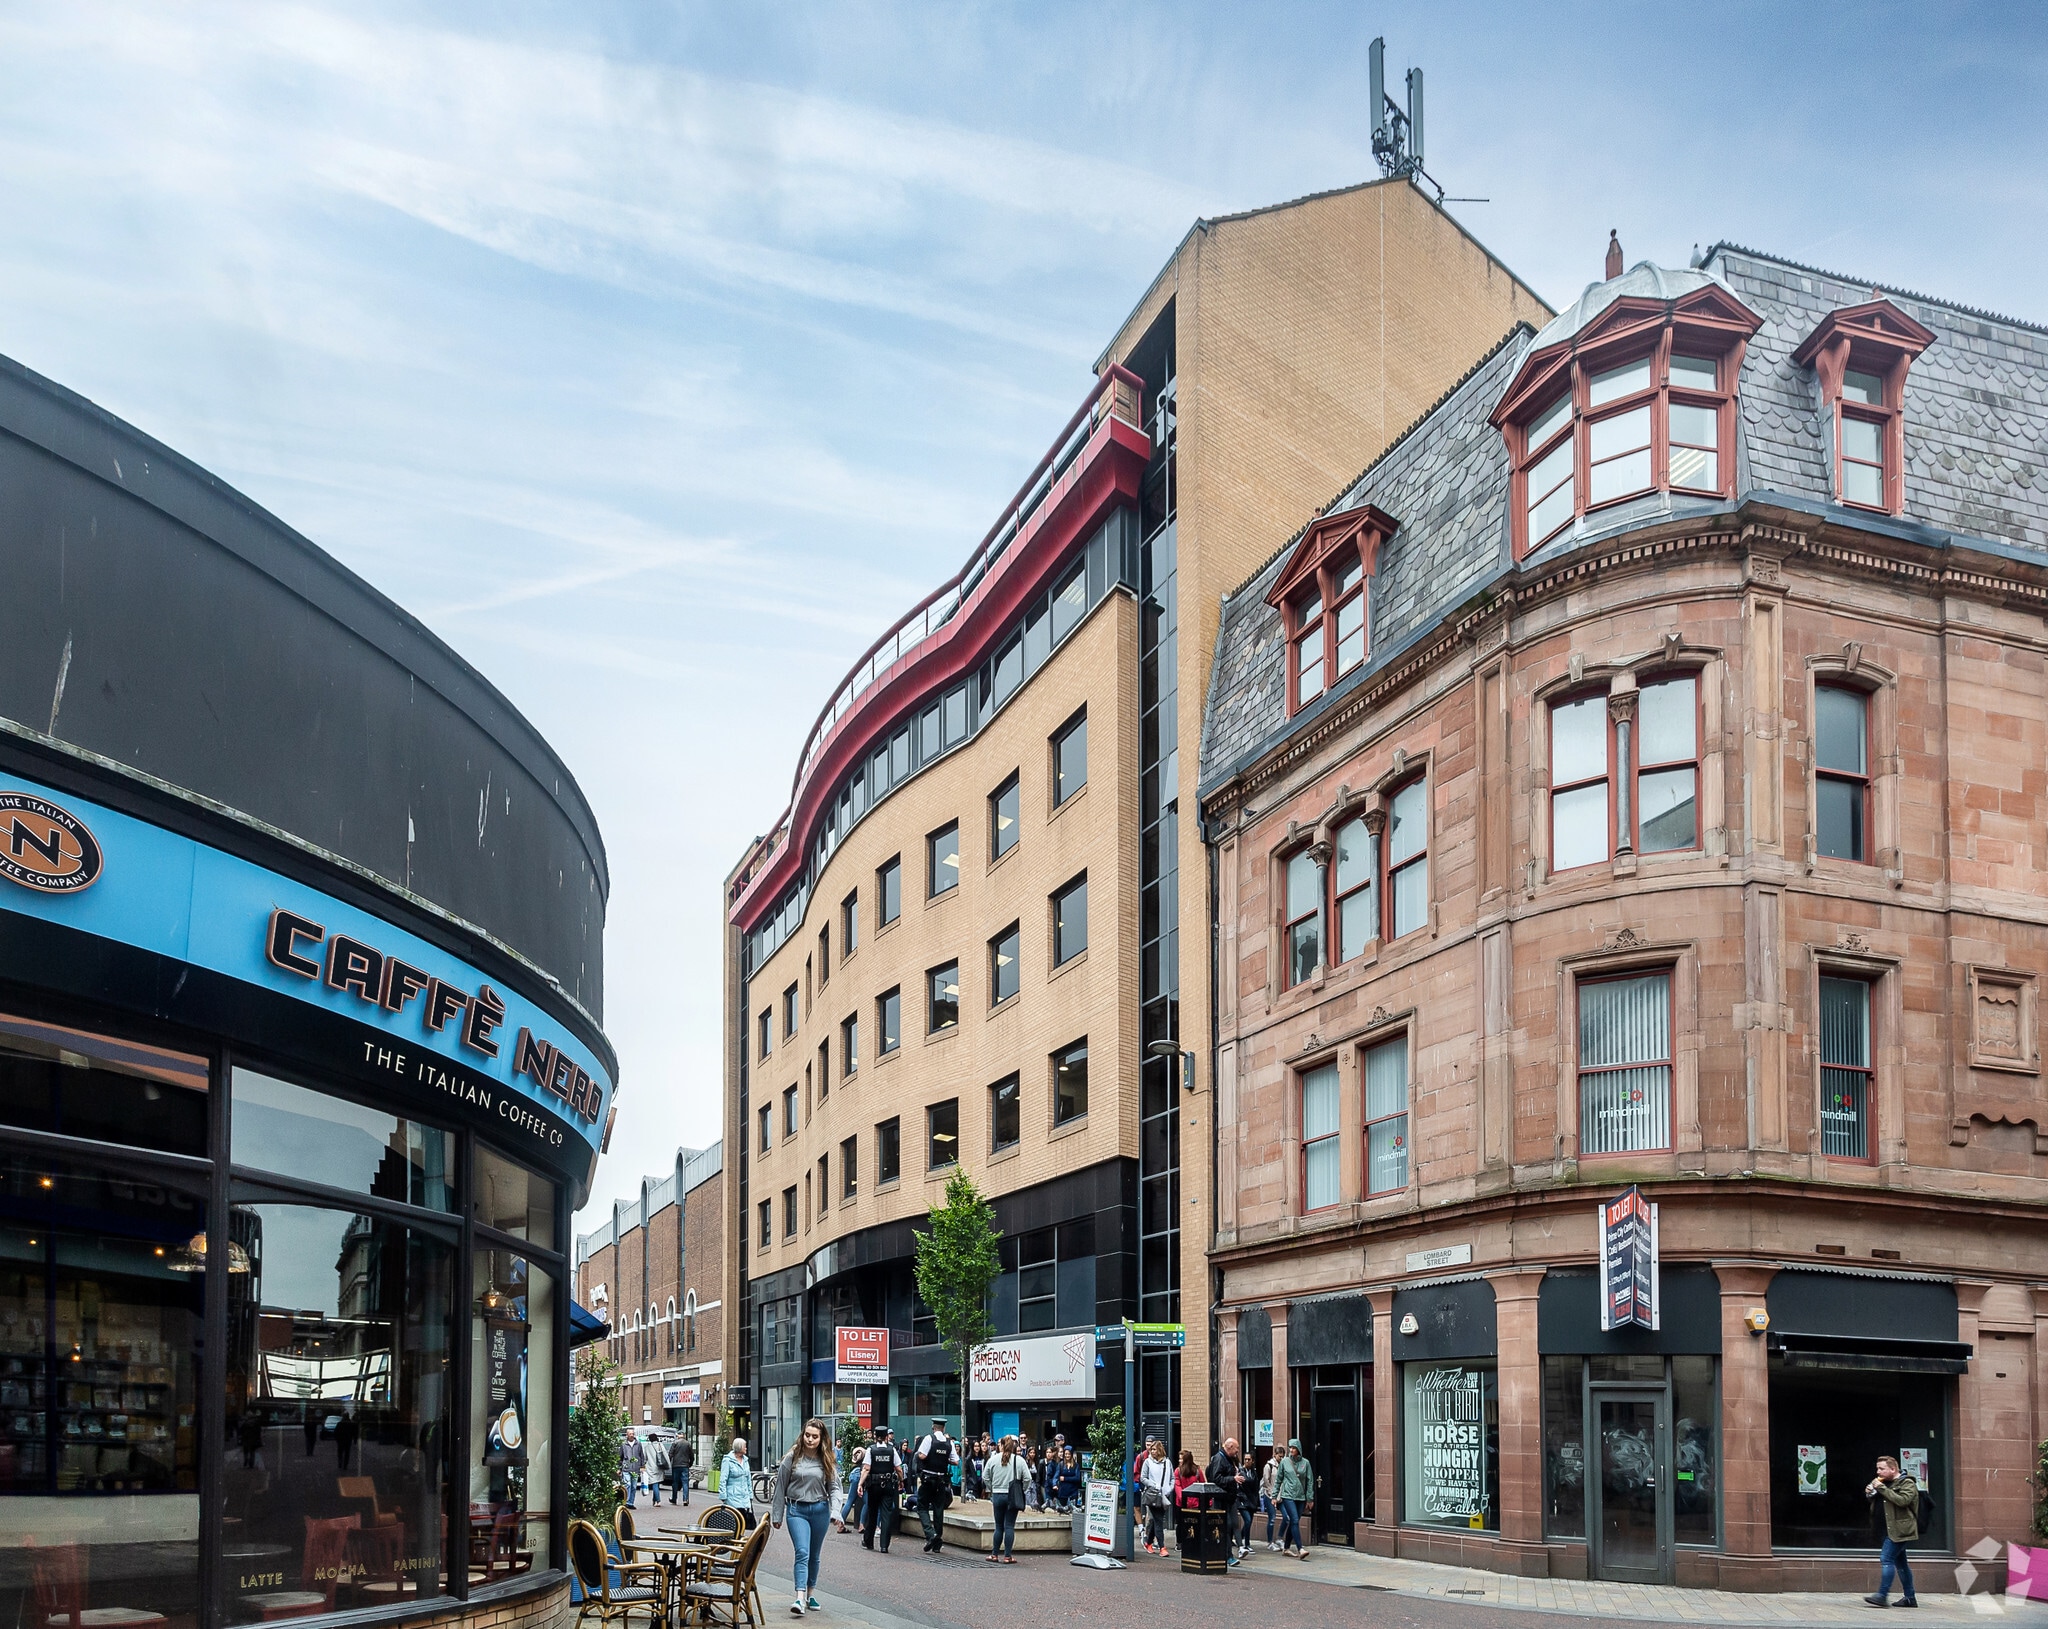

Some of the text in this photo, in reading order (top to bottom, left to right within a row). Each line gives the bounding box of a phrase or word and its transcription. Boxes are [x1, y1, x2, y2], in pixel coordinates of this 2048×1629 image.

[0, 798, 76, 830] THE ITALIAN
[11, 816, 62, 868] N
[0, 856, 89, 887] FEE COMPANY
[265, 908, 604, 1125] CAFFÈ NERO
[364, 1042, 406, 1074] THE
[418, 1063, 492, 1110] ITALIAN
[499, 1100, 547, 1139] COFFEE
[1599, 1104, 1650, 1119] mindmill
[1820, 1108, 1857, 1122] mindmill
[1377, 1147, 1407, 1163] mindmill
[1612, 1196, 1631, 1223] TO LET
[1423, 1249, 1452, 1261] LOMBARD
[1426, 1257, 1449, 1268] STREET
[842, 1331, 884, 1341] TO LET
[850, 1350, 876, 1361] Lisney
[973, 1349, 1021, 1367] AMERICAN
[973, 1366, 1017, 1383] HOLIDAYS
[1422, 1367, 1467, 1392] Whether
[1466, 1372, 1479, 1380] YOU
[1467, 1381, 1478, 1389] EAT
[858, 1403, 867, 1413] TO
[1423, 1391, 1479, 1420] LIKE A BIRD
[1424, 1425, 1479, 1444] HORSE
[1424, 1449, 1479, 1468] HUNGRY
[1424, 1468, 1479, 1480] SHOPPER
[1424, 1486, 1480, 1500] ANY NUMBER OF
[1424, 1494, 1480, 1515] Cure-alls
[314, 1563, 367, 1581] MOCHA
[393, 1557, 436, 1572] PANINI
[240, 1572, 283, 1589] LATTE
